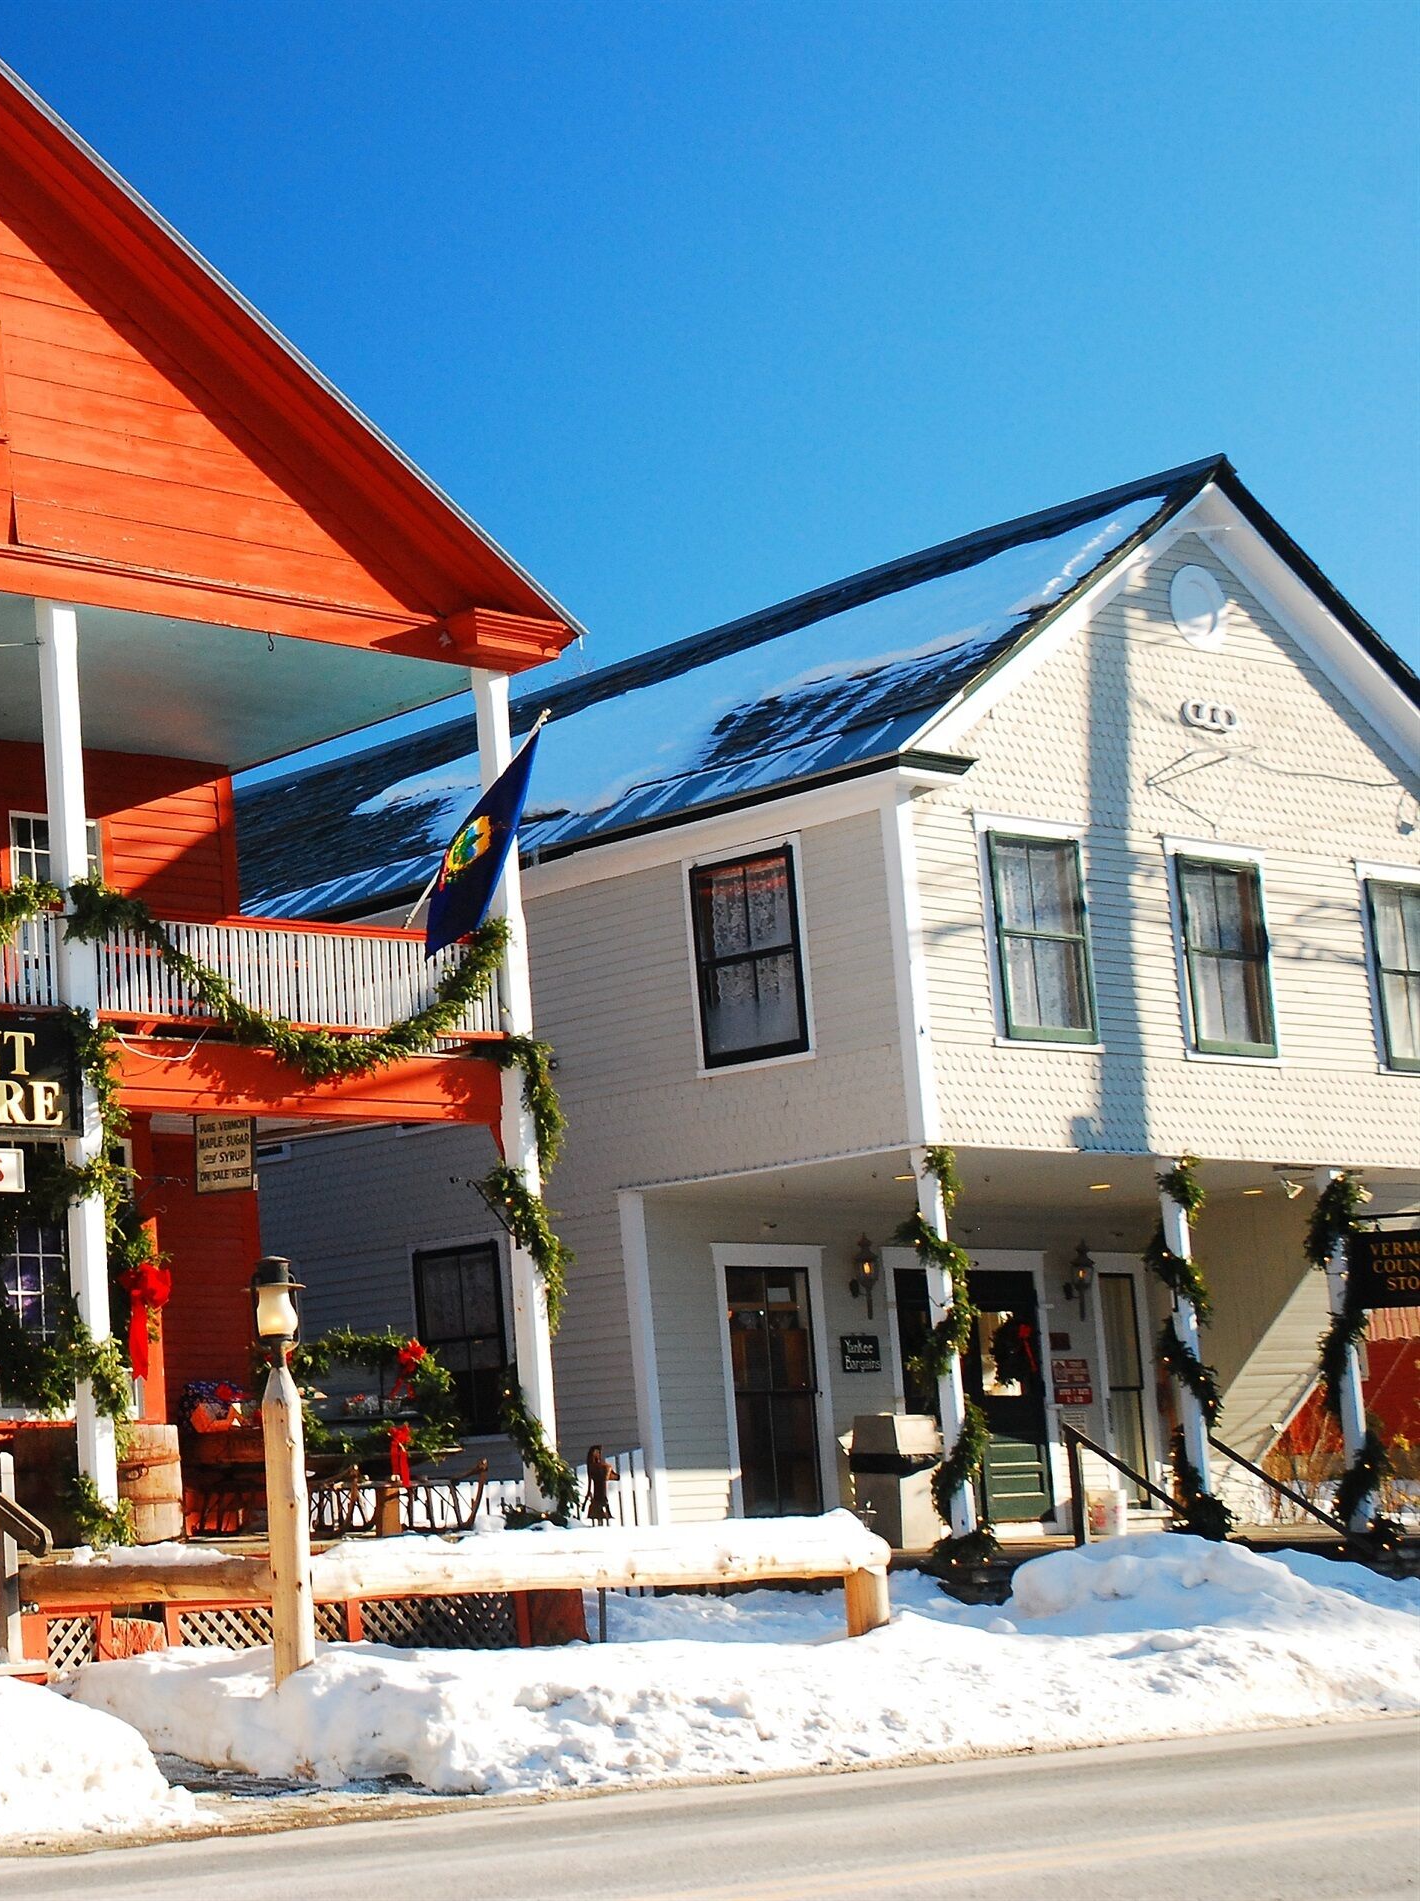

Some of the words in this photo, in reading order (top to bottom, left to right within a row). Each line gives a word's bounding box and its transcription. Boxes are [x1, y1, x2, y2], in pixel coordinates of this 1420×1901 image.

[200, 1122, 216, 1134] PURE
[219, 1119, 249, 1131] VERMONT
[199, 1136, 223, 1149] MAPLE
[227, 1133, 250, 1146] SUGAR
[203, 1152, 218, 1163] and
[219, 1150, 246, 1162] SYRUP
[200, 1171, 210, 1181] ON
[213, 1170, 229, 1180] SALE
[232, 1168, 251, 1178] HERE
[844, 1355, 884, 1372] Bargains
